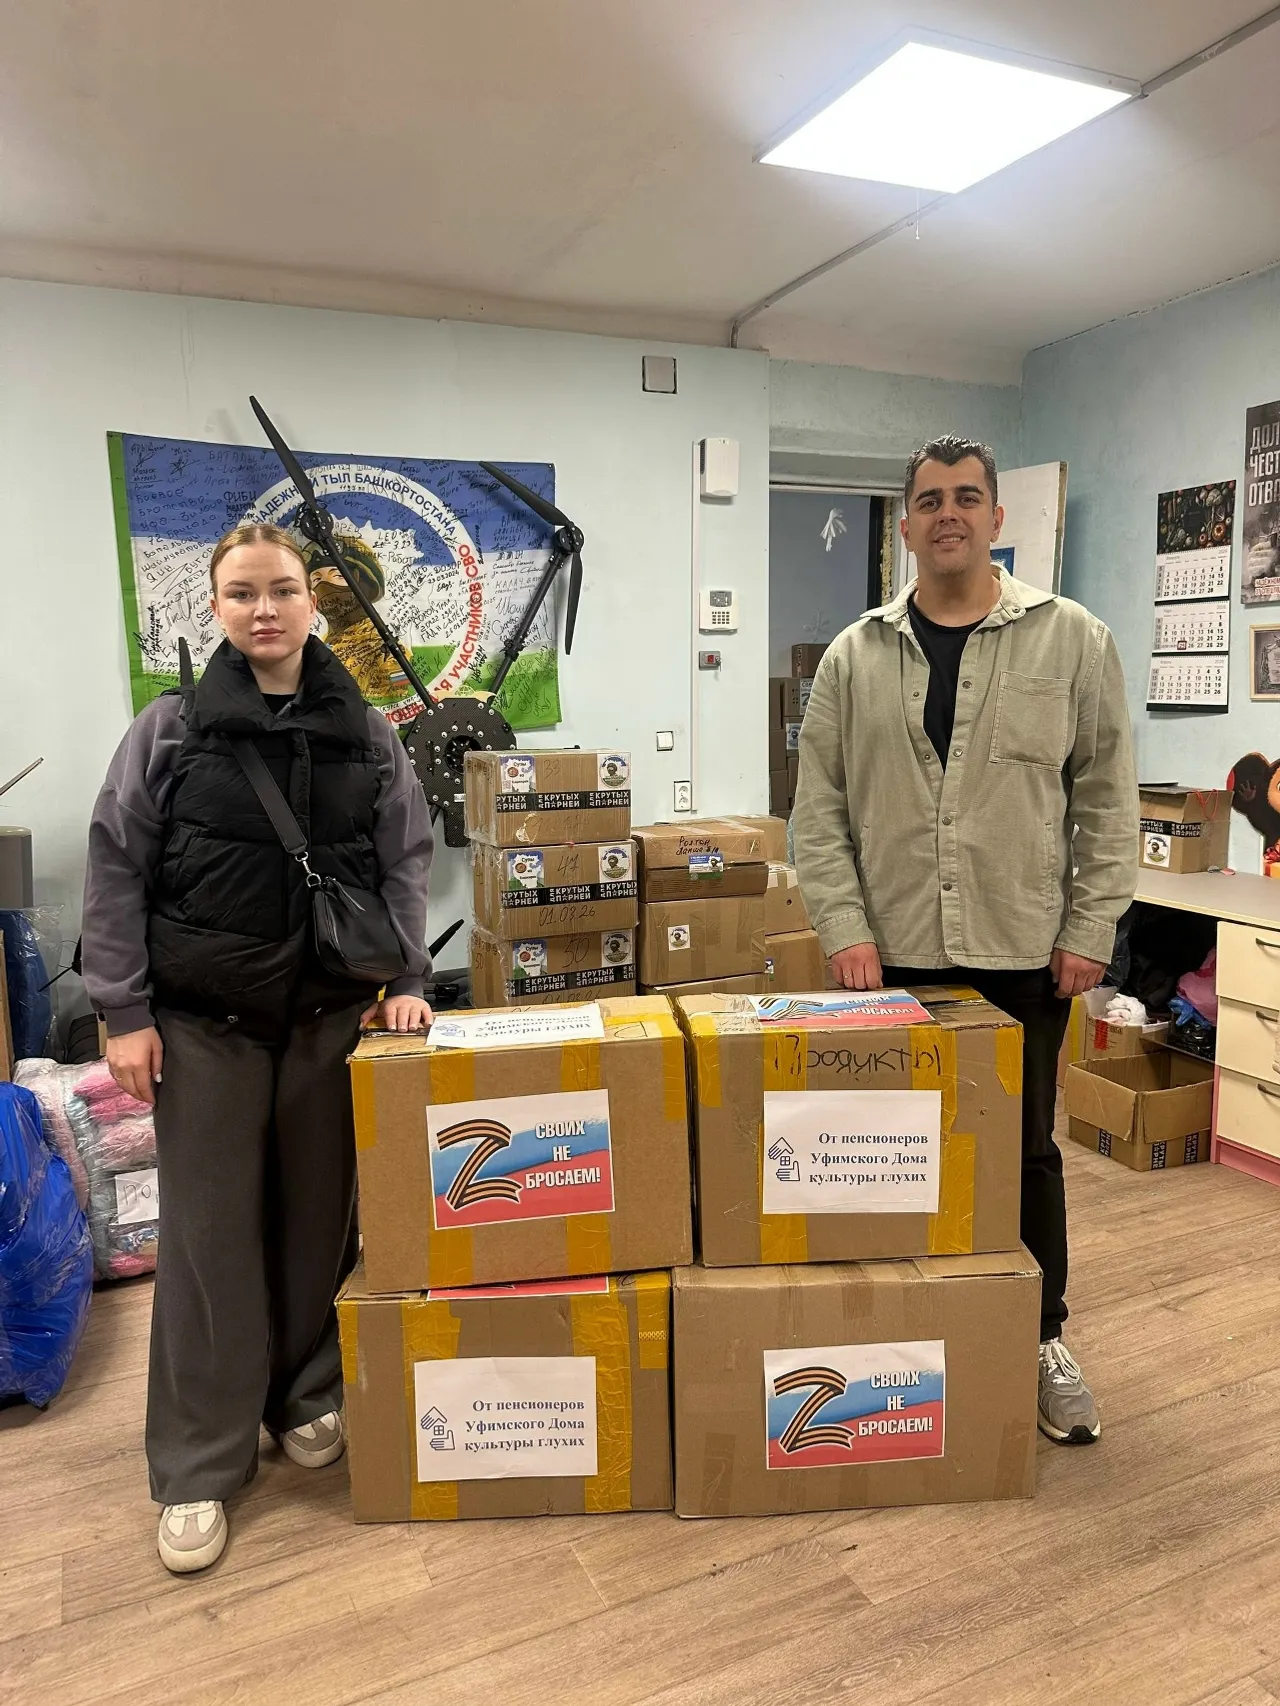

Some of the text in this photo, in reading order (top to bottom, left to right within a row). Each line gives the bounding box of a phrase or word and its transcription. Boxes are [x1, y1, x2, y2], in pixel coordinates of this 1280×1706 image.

[1250, 422, 1280, 454] ДОЛ
[1250, 450, 1280, 477] ЧЕСТ
[321, 473, 350, 485] ТЫЛ
[1249, 479, 1280, 507] ОТВА
[459, 544, 478, 578] СВО
[449, 581, 483, 679] УЧАСТНИКОВ
[545, 793, 579, 801] КРУТЫХ
[595, 791, 629, 799] КРУТЫХ
[502, 890, 538, 899] КРУТЫХ
[556, 886, 590, 895] КРУТЫХ
[532, 975, 565, 985] КРУТЫХ
[582, 969, 614, 978] КРУТЫХ
[535, 1120, 585, 1139] СВОИХ
[819, 1133, 928, 1147] От пенсионеров
[553, 1145, 571, 1162] НЕ
[810, 1153, 927, 1166] Уфимского Дома
[525, 1167, 600, 1189] БРОСАЕМ!
[809, 1173, 927, 1185] культуры глухих
[870, 1371, 920, 1389] СВОИХ
[473, 1400, 584, 1412] От пенсионеров
[887, 1396, 905, 1410] НЕ
[465, 1418, 584, 1434] Уфимского Дома
[858, 1417, 932, 1436] БРОСАЕМ!
[465, 1438, 585, 1452] культуры глухих
